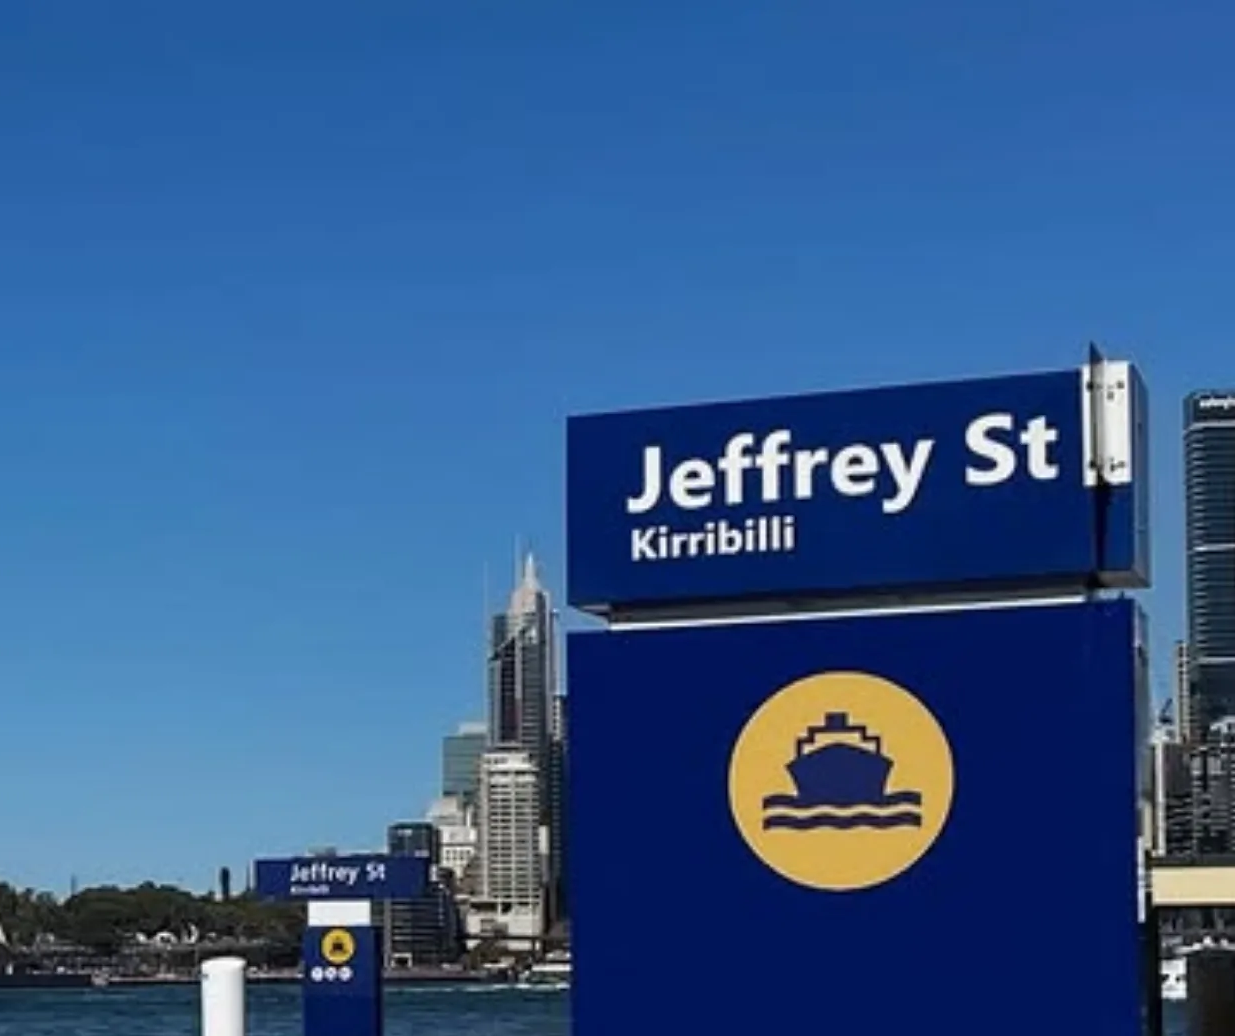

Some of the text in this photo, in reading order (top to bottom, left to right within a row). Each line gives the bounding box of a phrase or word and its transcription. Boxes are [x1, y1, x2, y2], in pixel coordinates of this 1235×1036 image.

[627, 413, 1058, 513] Jeffrey St
[631, 516, 795, 561] Kirribilli
[290, 862, 385, 885] Jeffrey St
